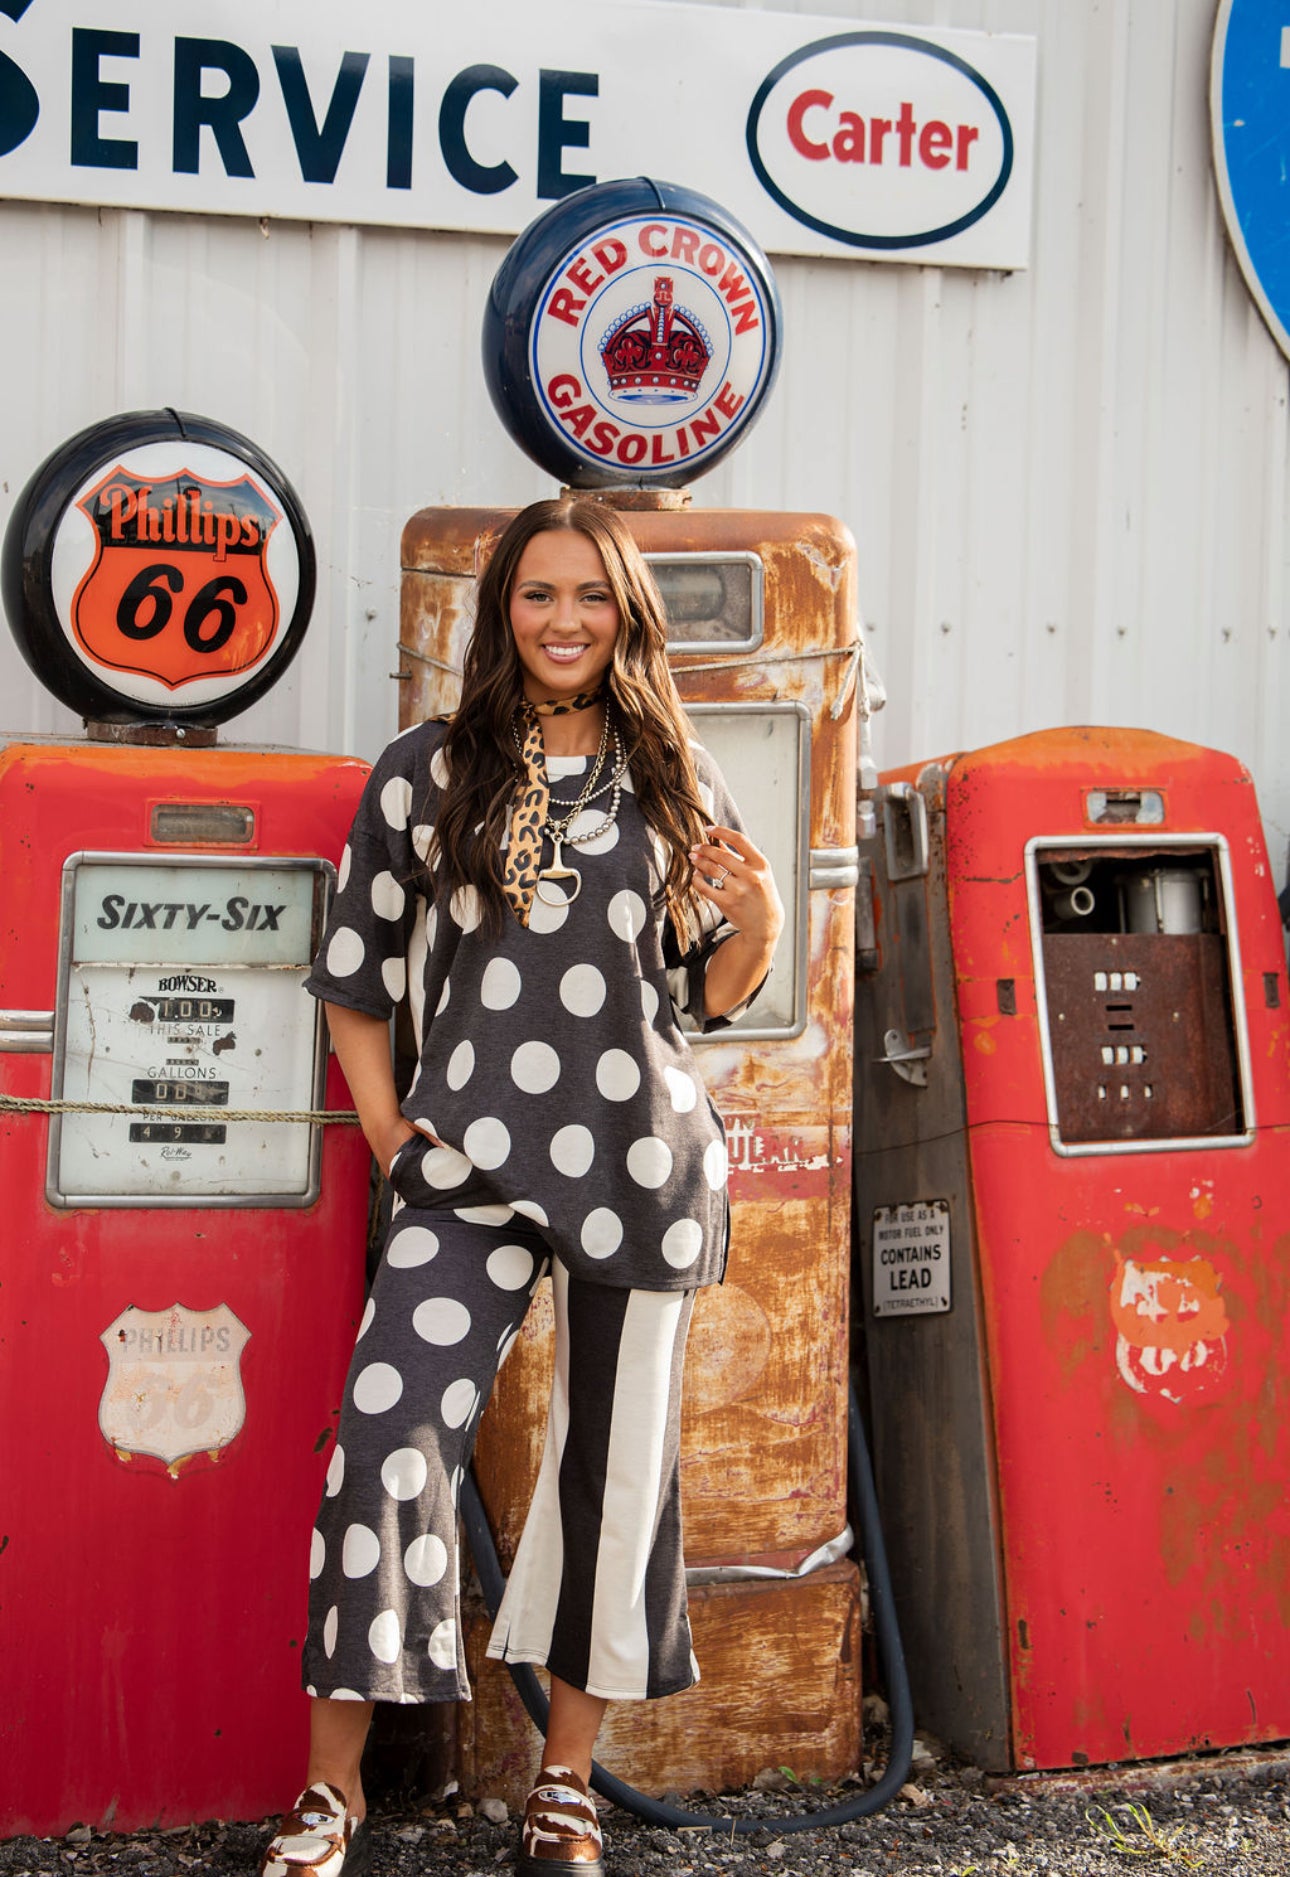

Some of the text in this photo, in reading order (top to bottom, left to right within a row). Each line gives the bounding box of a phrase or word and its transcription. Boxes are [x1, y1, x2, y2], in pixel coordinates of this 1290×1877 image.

[787, 89, 979, 171] Carter
[547, 224, 759, 336] RED CROWN
[548, 374, 745, 464] GASOLINE
[100, 483, 260, 562] Phillips
[116, 563, 249, 653] 66
[159, 975, 217, 993] BOWSER
[150, 1023, 221, 1037] THIS SALE
[147, 1066, 217, 1080] GALLONS
[901, 1210, 915, 1222] USE
[918, 1209, 928, 1221] AS
[879, 1225, 943, 1240] MOTOR FUEL ONLY
[881, 1244, 942, 1265] CONTAINS
[890, 1268, 931, 1290] LEAD
[123, 1326, 231, 1354] PHILLIPS
